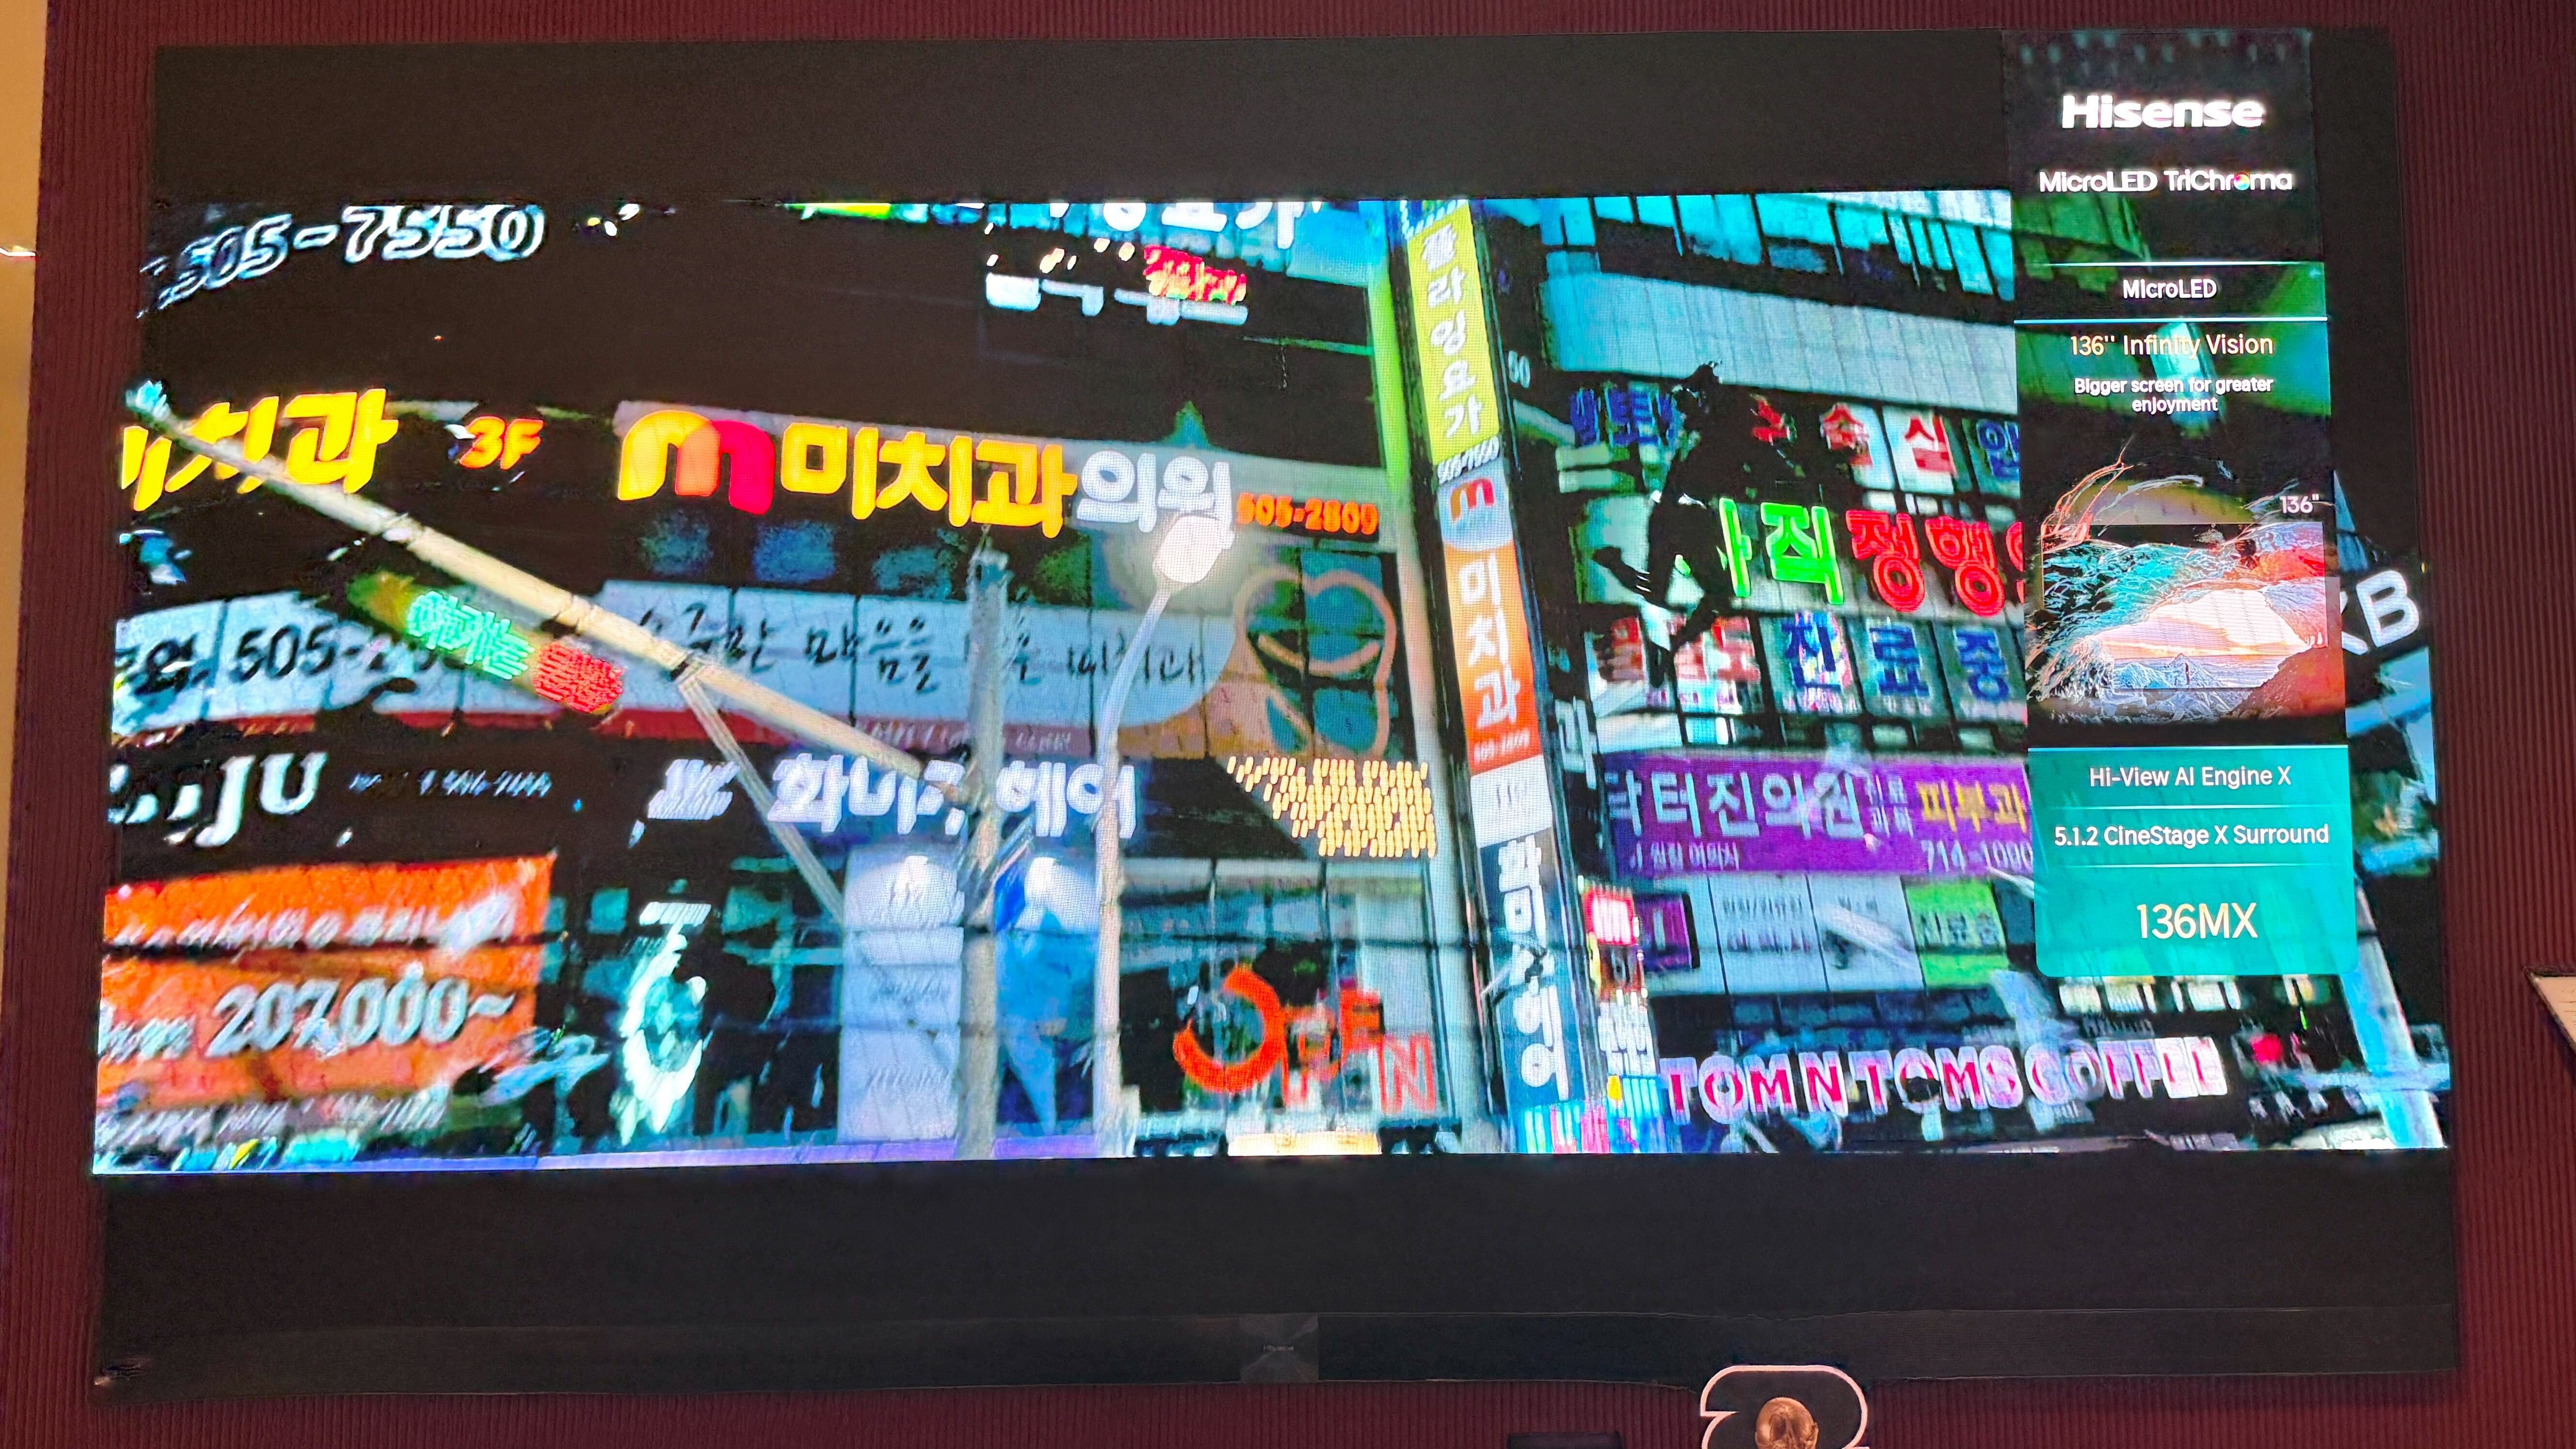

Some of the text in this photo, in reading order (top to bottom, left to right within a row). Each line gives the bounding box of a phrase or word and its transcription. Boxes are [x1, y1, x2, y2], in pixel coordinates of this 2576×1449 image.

[2062, 95, 2264, 128] Hisense
[2039, 169, 2293, 192] MicroLED TriChroma
[2123, 279, 2217, 299] MicroLED
[2123, 334, 2200, 360] Infinity
[2206, 334, 2273, 355] Vision
[2074, 377, 2274, 397] Bigger screen for greater
[2131, 397, 2218, 415] enjoyment
[459, 416, 544, 470] 3F
[1457, 551, 1520, 730] 미치과
[2090, 765, 2292, 790] Hi-View AI Engine X
[2054, 824, 2330, 849] 5.1.2 CineStage X Surround
[2136, 902, 2258, 940] 136MX
